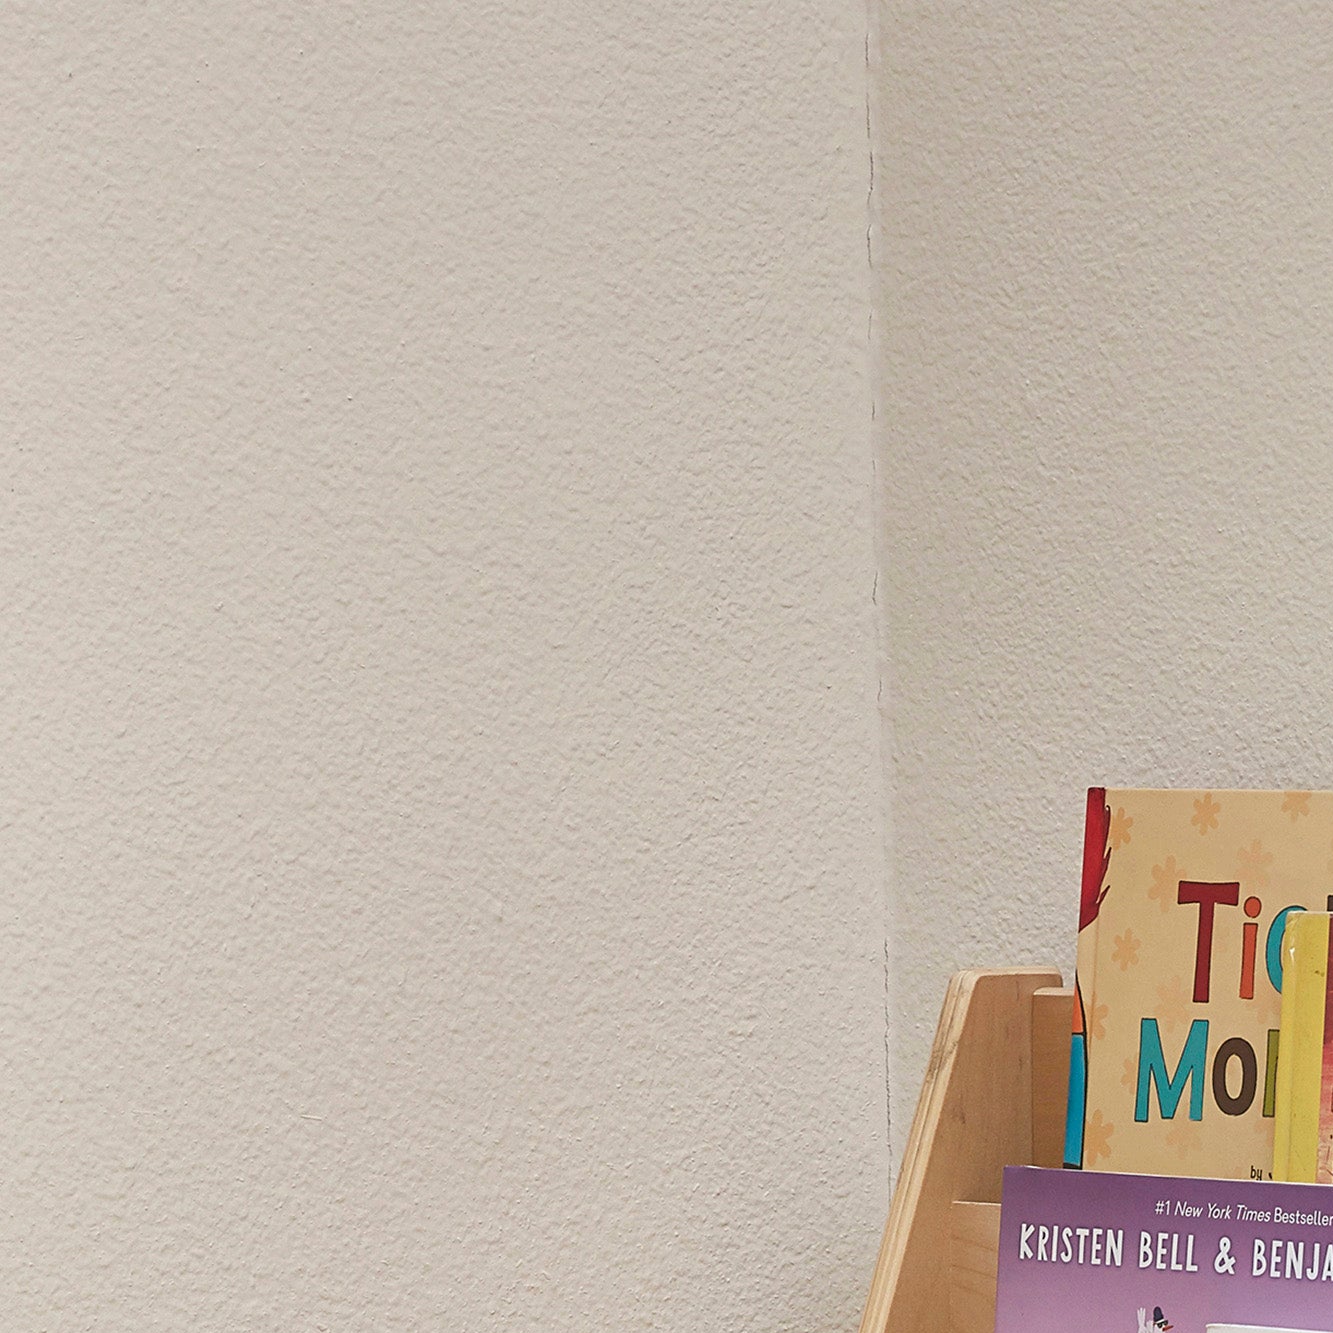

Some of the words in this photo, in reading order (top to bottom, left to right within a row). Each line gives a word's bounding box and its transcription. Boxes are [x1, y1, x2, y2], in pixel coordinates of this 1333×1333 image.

[1250, 1165, 1263, 1181] by
[1155, 1201, 1171, 1215] #1
[1174, 1201, 1203, 1218] New
[1207, 1203, 1232, 1220] York
[1236, 1205, 1271, 1222] Times
[1019, 1223, 1124, 1267] KRISTEN
[1138, 1230, 1198, 1272] BELL
[1213, 1236, 1237, 1275] &
